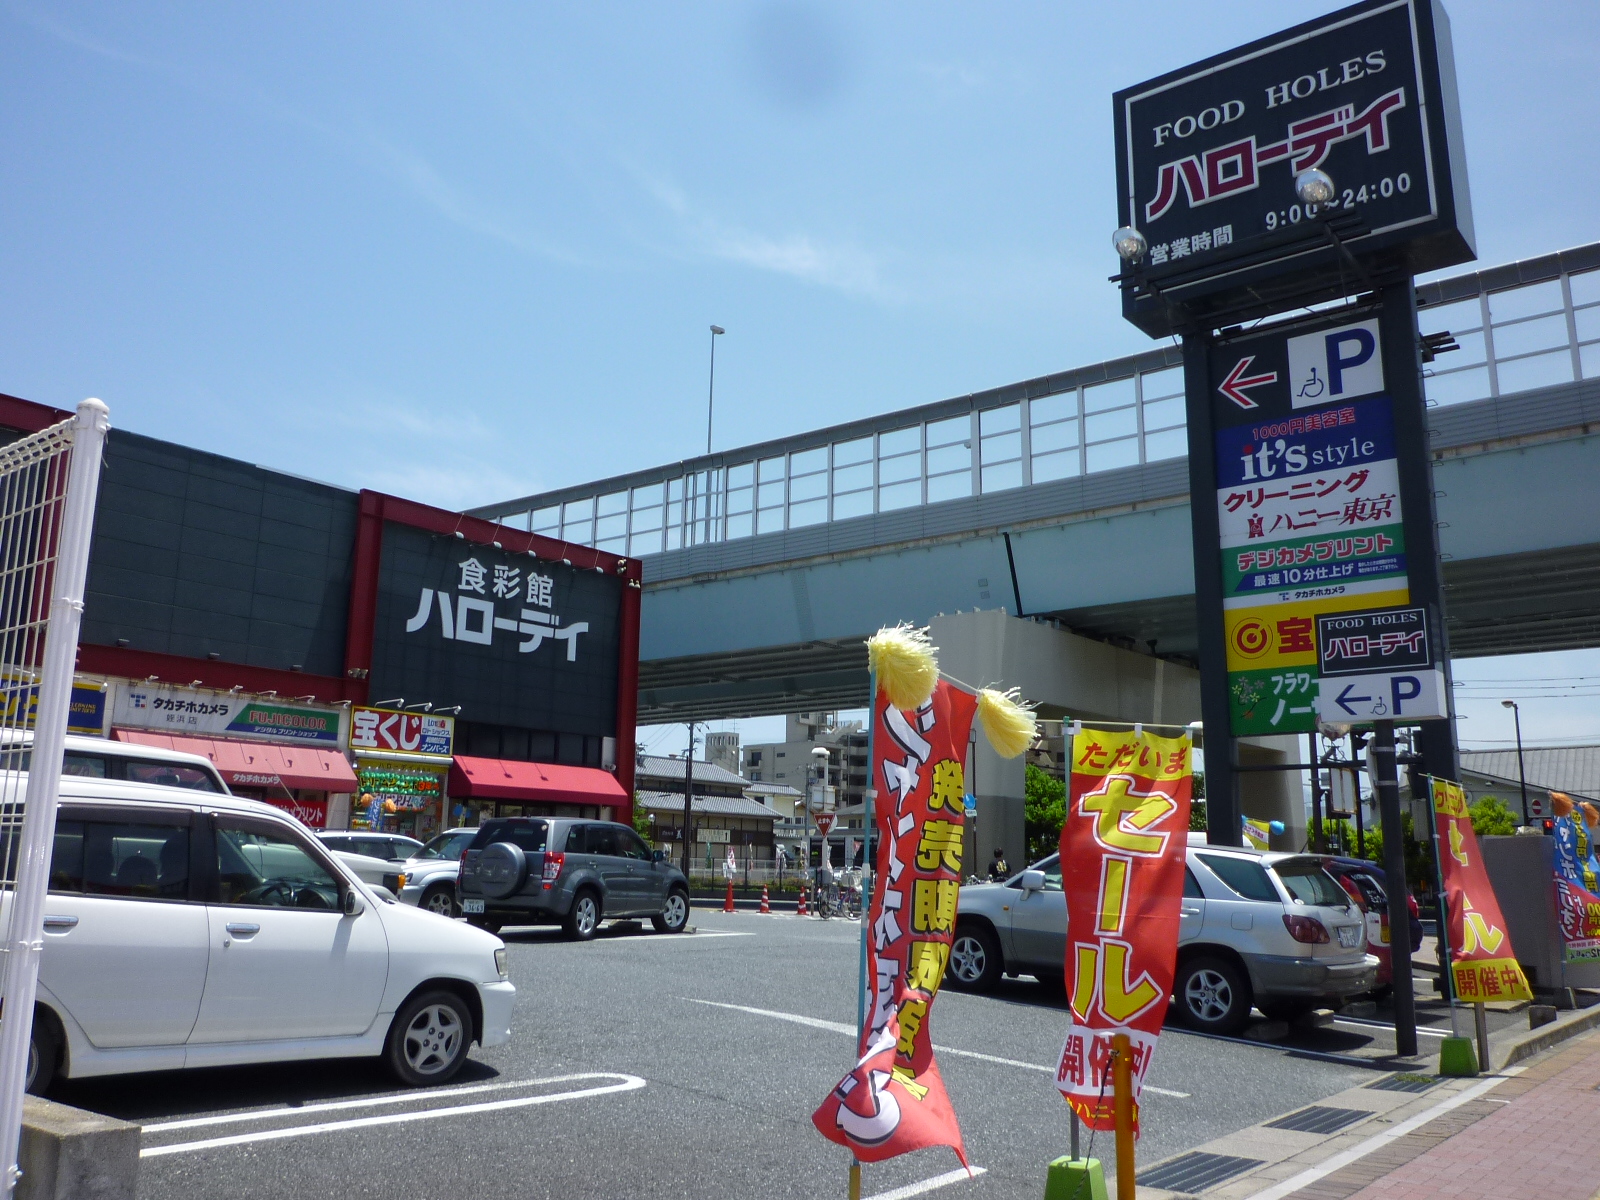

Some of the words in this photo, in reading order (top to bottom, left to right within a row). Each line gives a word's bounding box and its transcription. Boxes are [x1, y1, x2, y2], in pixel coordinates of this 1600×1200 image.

[1153, 100, 1246, 148] FOOD
[1265, 49, 1388, 110] HOLES
[1145, 86, 1407, 224] ハローデイ
[1150, 224, 1233, 266] 営業時間
[1325, 327, 1376, 396] P
[1252, 407, 1356, 440] 1000円美容室
[1312, 437, 1375, 466] style
[1223, 469, 1370, 513] クリーニング
[1269, 493, 1397, 533] ハニー東京
[1237, 533, 1393, 571] デジカメプリント
[457, 557, 554, 609] 食彩館
[1254, 563, 1354, 587] 最速10分仕上げ
[1294, 585, 1346, 600] タカチホカメラ
[406, 587, 589, 662] ハローデイ
[1327, 618, 1365, 631] FOOD
[1371, 612, 1418, 625] HOLES
[1325, 630, 1424, 660] ハローデイ
[153, 697, 229, 716] タカチホカメラ
[1270, 697, 1322, 726] ノー
[1390, 675, 1421, 716] P
[249, 710, 326, 730] FUJICOLOR
[352, 710, 420, 750] 宝くじ
[421, 743, 449, 754] ナンバーズ
[1078, 740, 1188, 775] ただいま
[232, 773, 281, 785] タカチホカメラ
[1070, 774, 1177, 1026] セール
